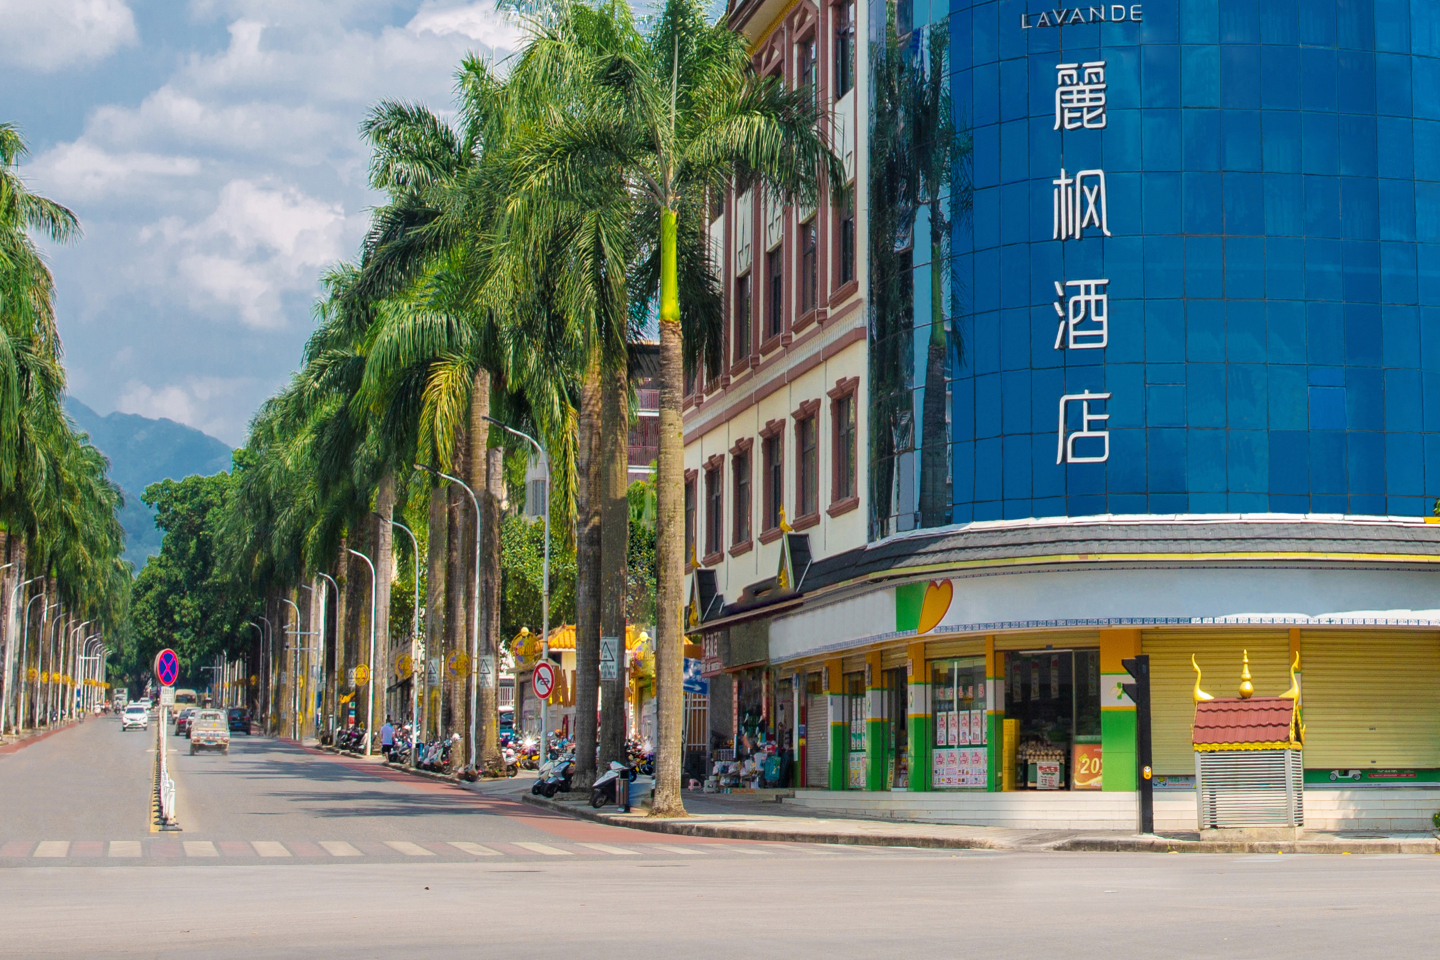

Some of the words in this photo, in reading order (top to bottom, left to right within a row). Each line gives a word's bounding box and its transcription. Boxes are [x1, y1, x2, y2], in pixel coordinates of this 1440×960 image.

[1021, 4, 1143, 29] LAVANDE
[1053, 61, 1112, 465] 麗枫酒店
